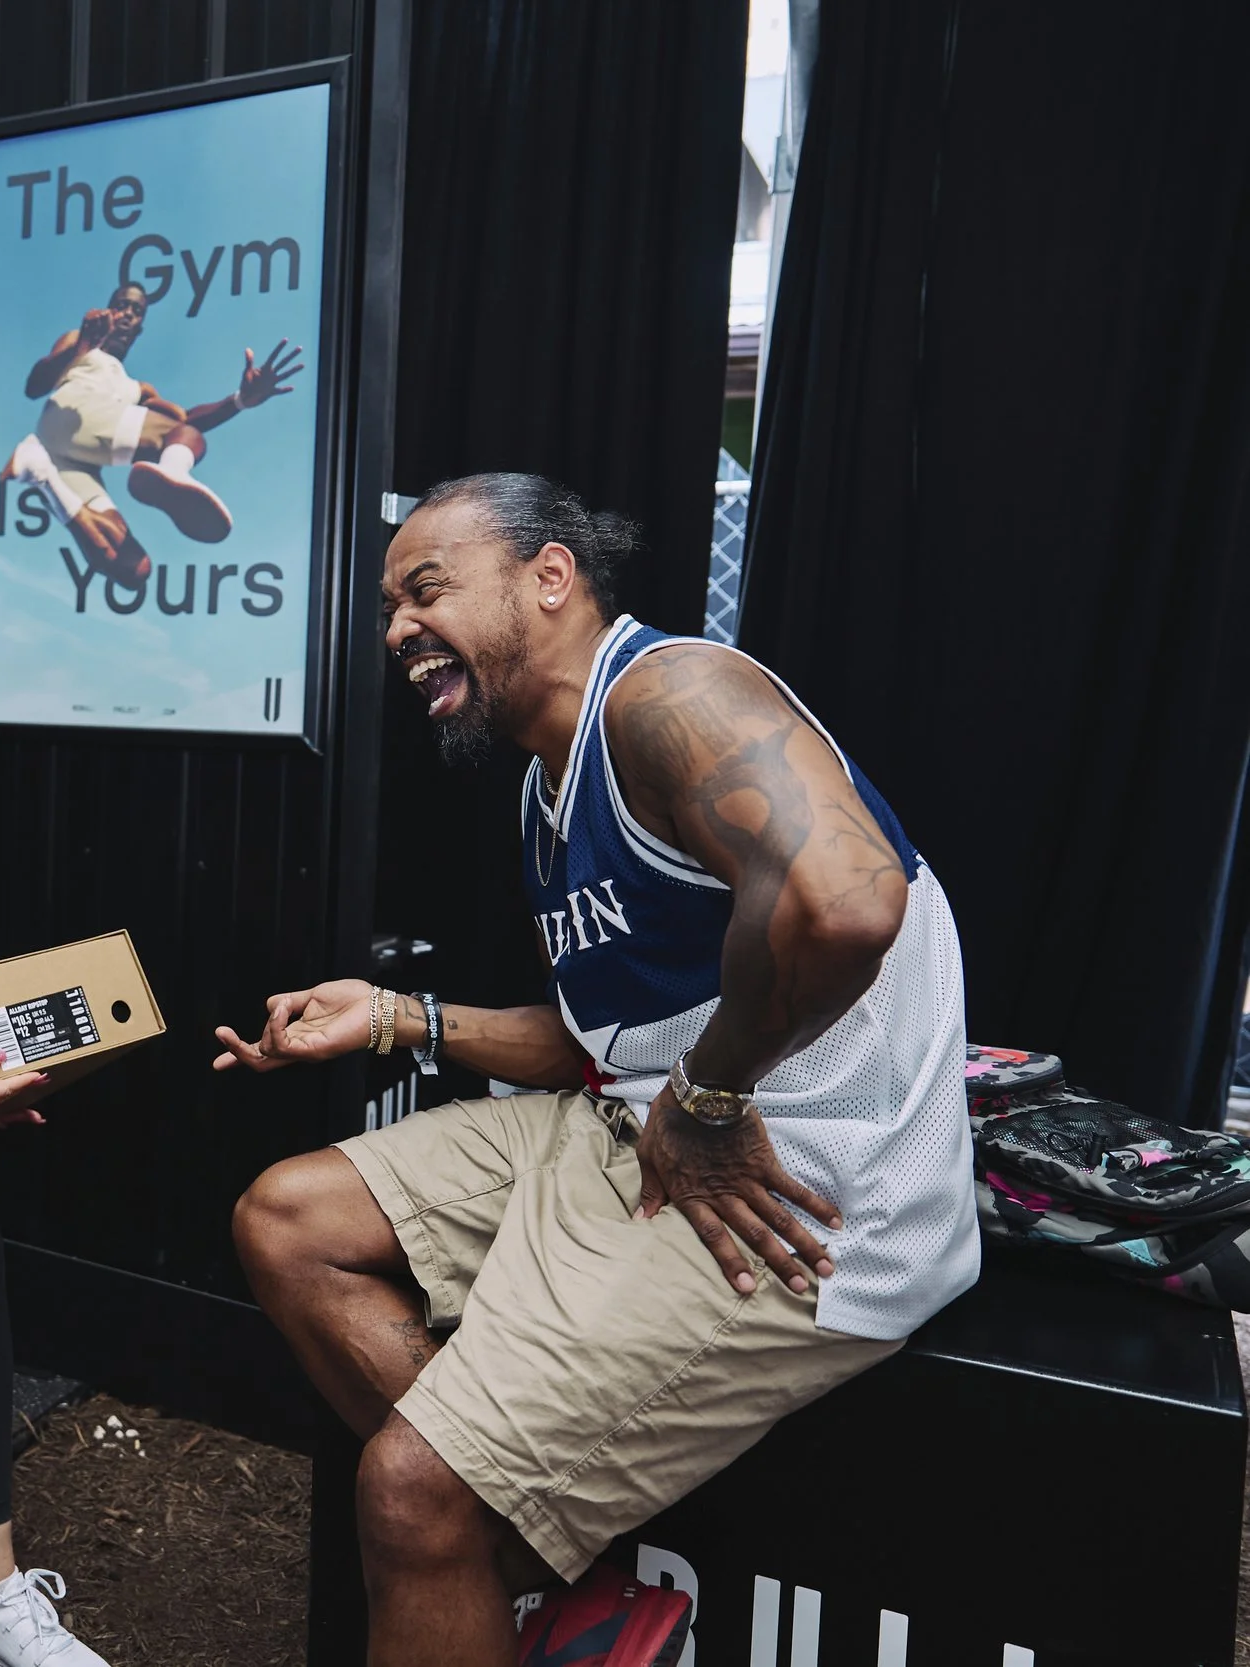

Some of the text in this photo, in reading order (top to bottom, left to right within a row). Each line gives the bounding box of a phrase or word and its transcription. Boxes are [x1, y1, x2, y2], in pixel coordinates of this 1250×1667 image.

[6, 166, 144, 239] The
[118, 234, 301, 318] Gym
[66, 989, 95, 1044] NOBULL
[427, 1005, 438, 1038] escape
